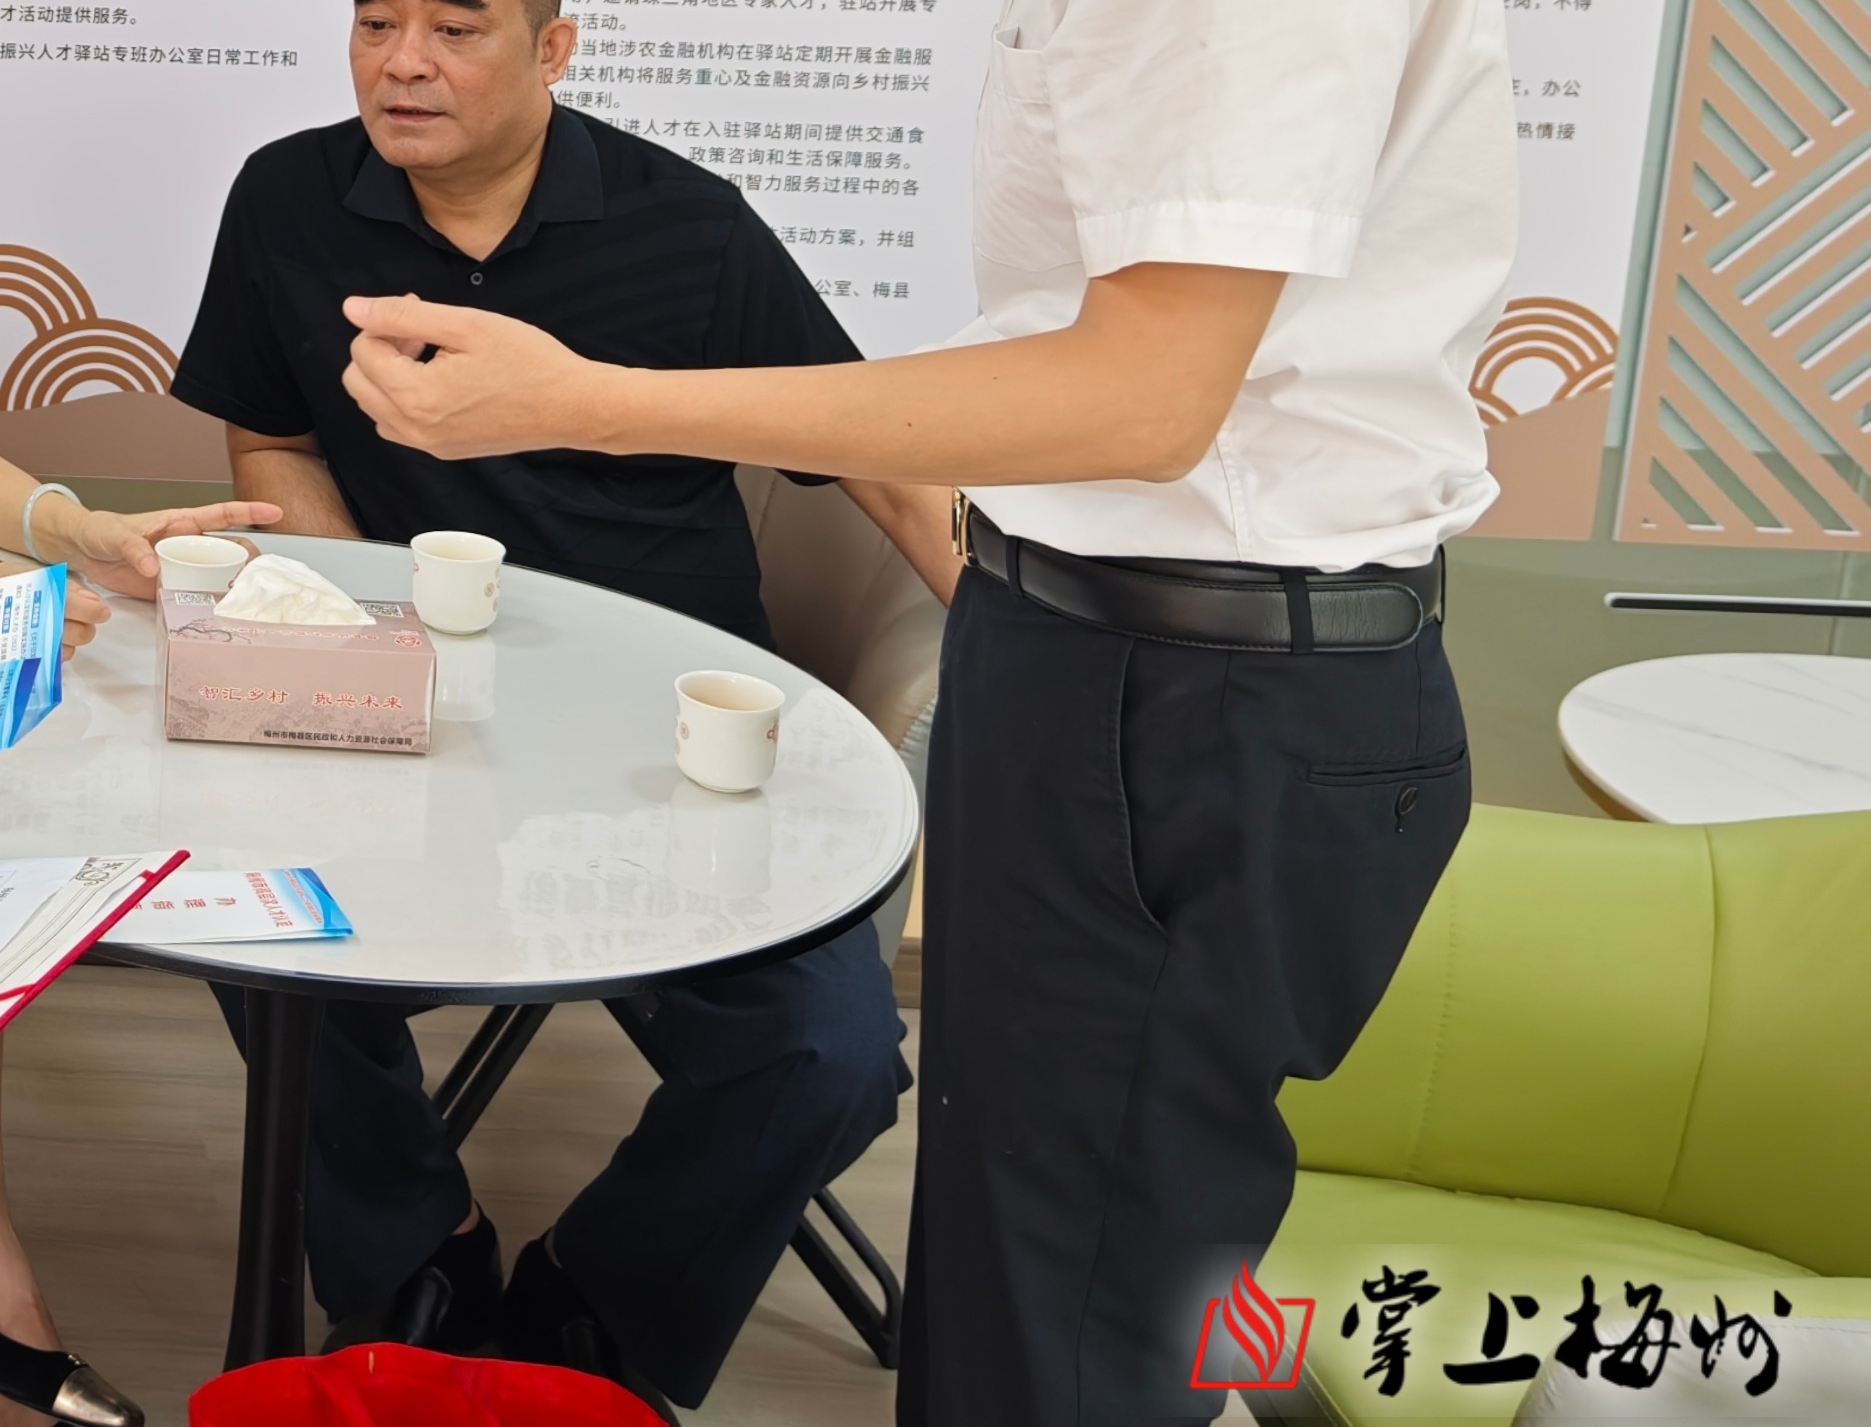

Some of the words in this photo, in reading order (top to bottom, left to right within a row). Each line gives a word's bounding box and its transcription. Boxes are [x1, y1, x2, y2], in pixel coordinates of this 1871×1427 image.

[689, 147, 910, 169] 政策咨询和生活保障服务。
[200, 685, 289, 704] 智汇乡村
[313, 691, 404, 710] 振兴未来
